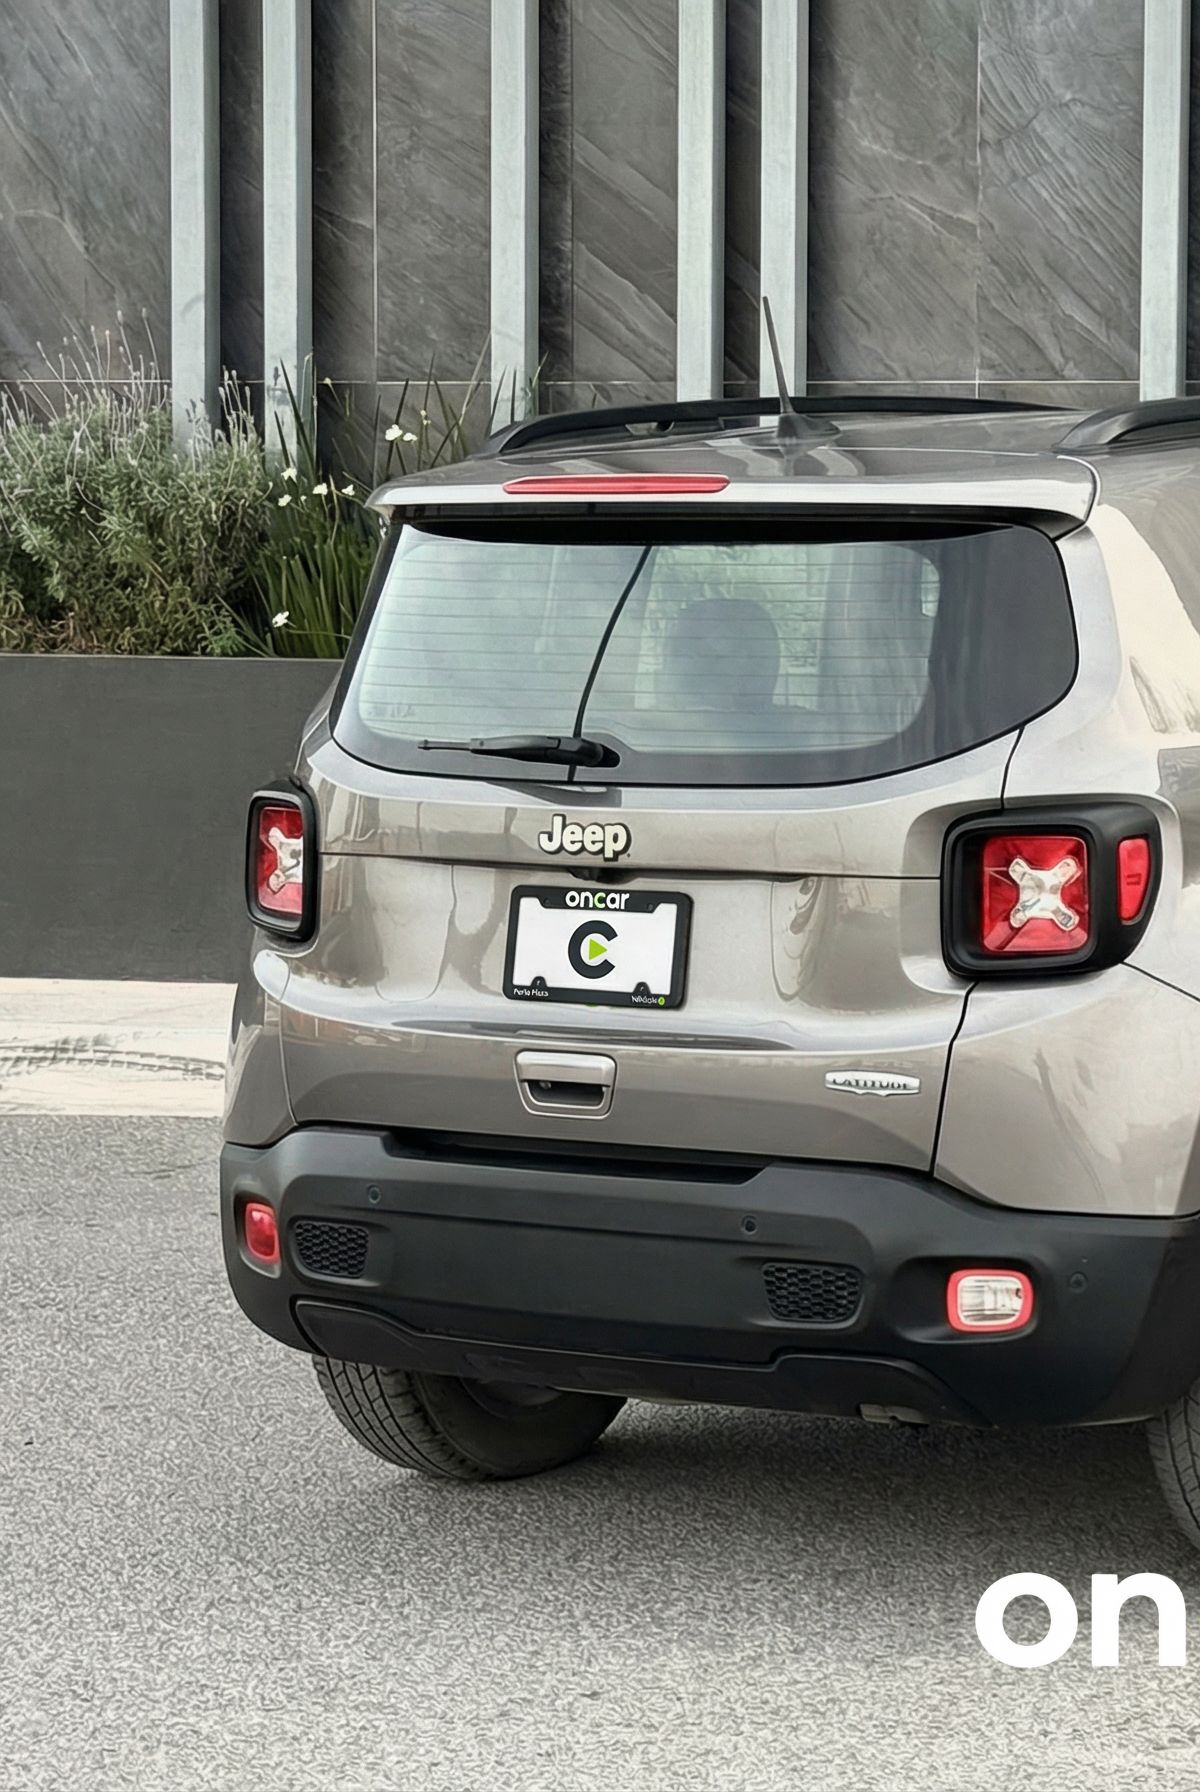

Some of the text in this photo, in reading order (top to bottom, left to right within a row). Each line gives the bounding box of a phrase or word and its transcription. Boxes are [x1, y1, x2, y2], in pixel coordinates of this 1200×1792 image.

[538, 814, 632, 861] Jeep
[565, 890, 630, 910] oncar
[568, 920, 618, 980] C
